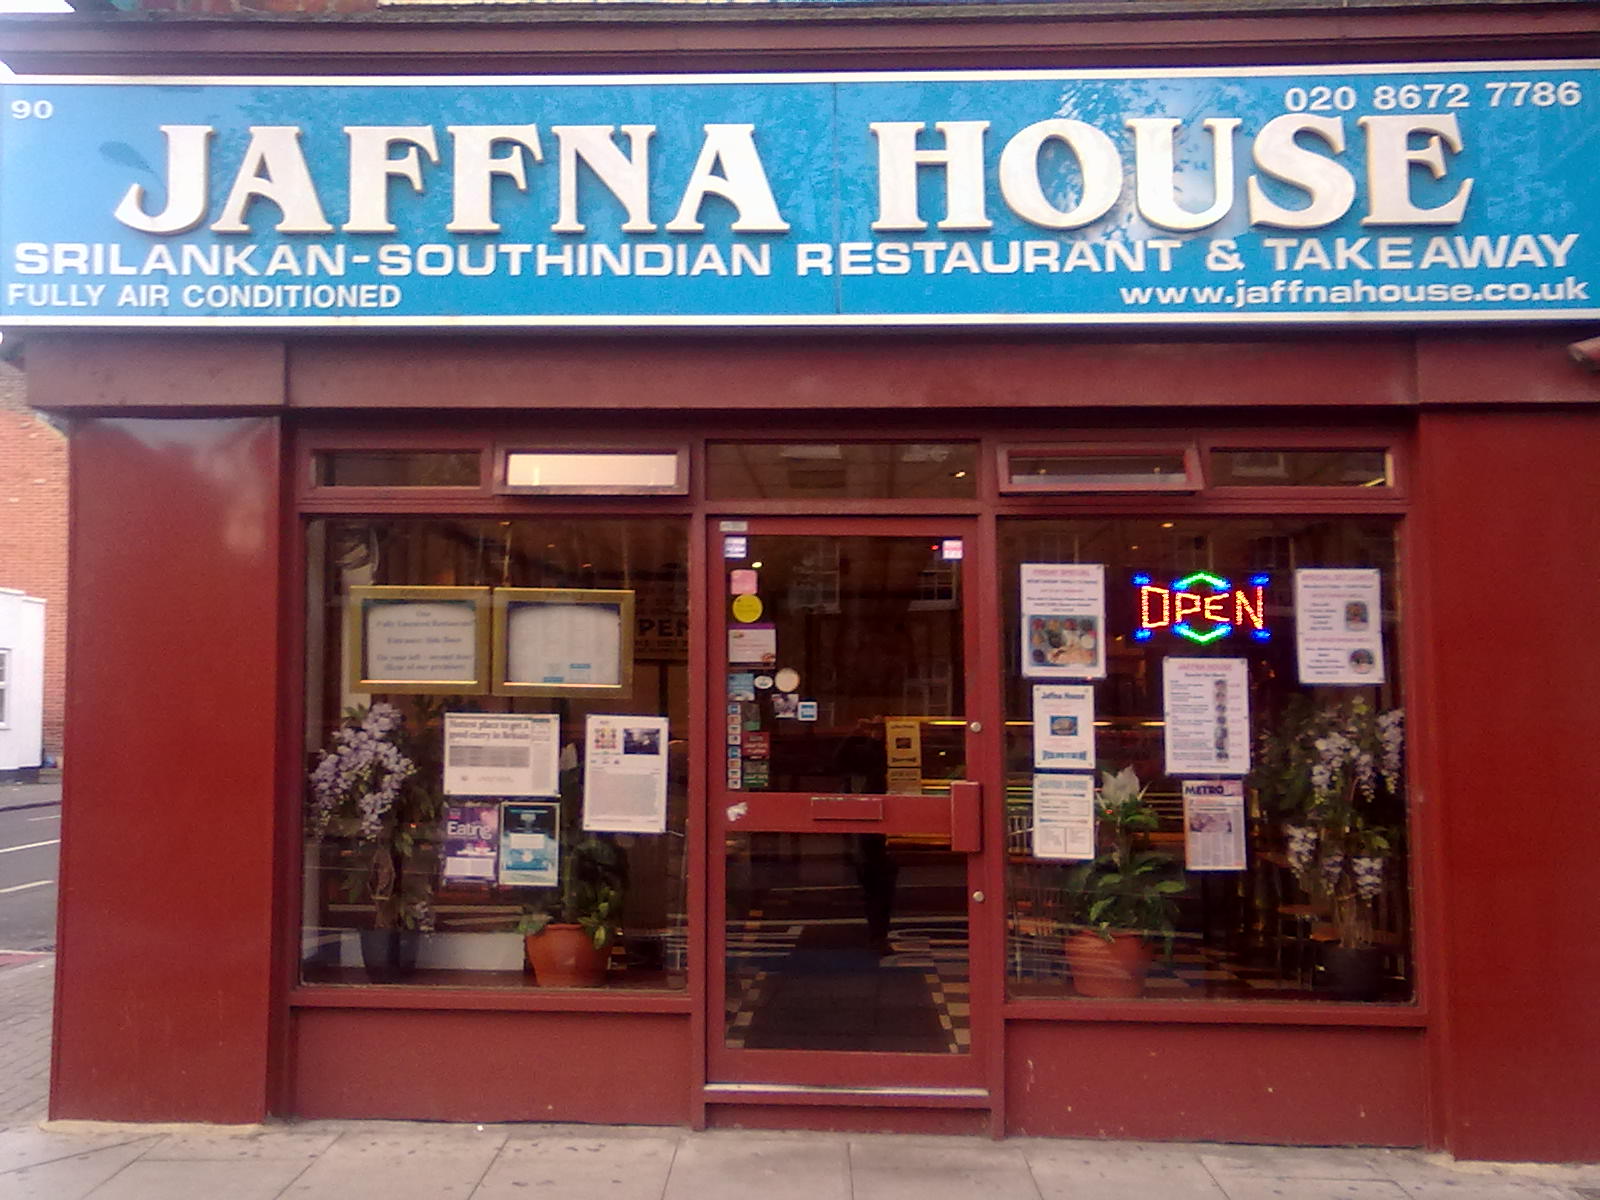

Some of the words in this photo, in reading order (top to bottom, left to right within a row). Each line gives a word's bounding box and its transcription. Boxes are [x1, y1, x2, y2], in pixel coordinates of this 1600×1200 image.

[11, 99, 53, 120] 90
[1285, 87, 1357, 113] 020
[1373, 84, 1470, 110] 8672
[1486, 81, 1582, 107] 7786
[114, 123, 791, 234] JAFFNA
[869, 111, 1475, 231] HOUSE
[14, 241, 771, 278] SRILANKAN-SOUTHINDIAN
[795, 239, 1183, 277] RESTAURANT
[1206, 239, 1246, 272] &
[1264, 233, 1580, 272] TAKEAWAY
[7, 284, 106, 308] FULLY
[118, 284, 170, 308] AIR
[182, 284, 402, 309] CONDITIONED
[1119, 276, 1591, 310] www.jaffnahouse.co.uk
[1140, 585, 1264, 630] OPEN
[638, 618, 688, 637] PEN
[1184, 785, 1224, 795] METRO
